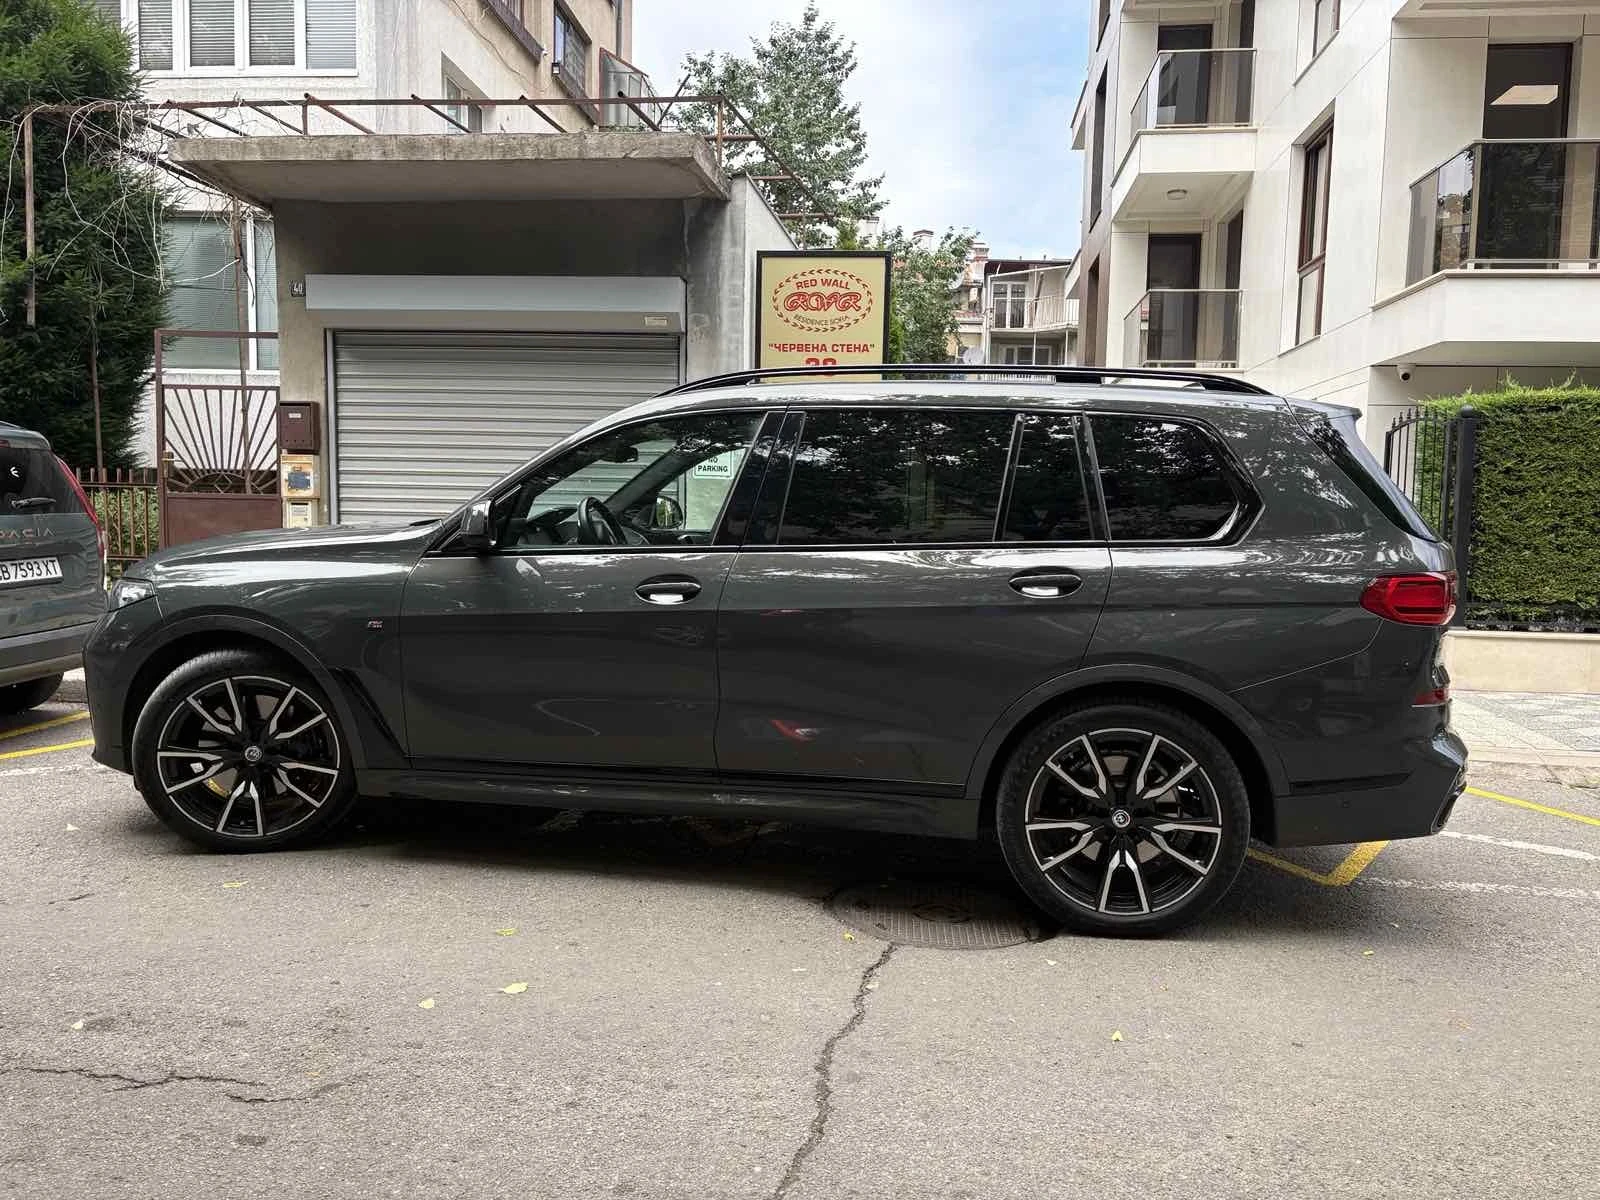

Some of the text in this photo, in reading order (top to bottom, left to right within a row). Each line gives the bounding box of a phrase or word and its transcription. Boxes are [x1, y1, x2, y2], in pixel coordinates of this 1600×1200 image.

[795, 279, 850, 290] RED WALL
[768, 343, 875, 353] "ЧЕРВЕНА СТЕНА"
